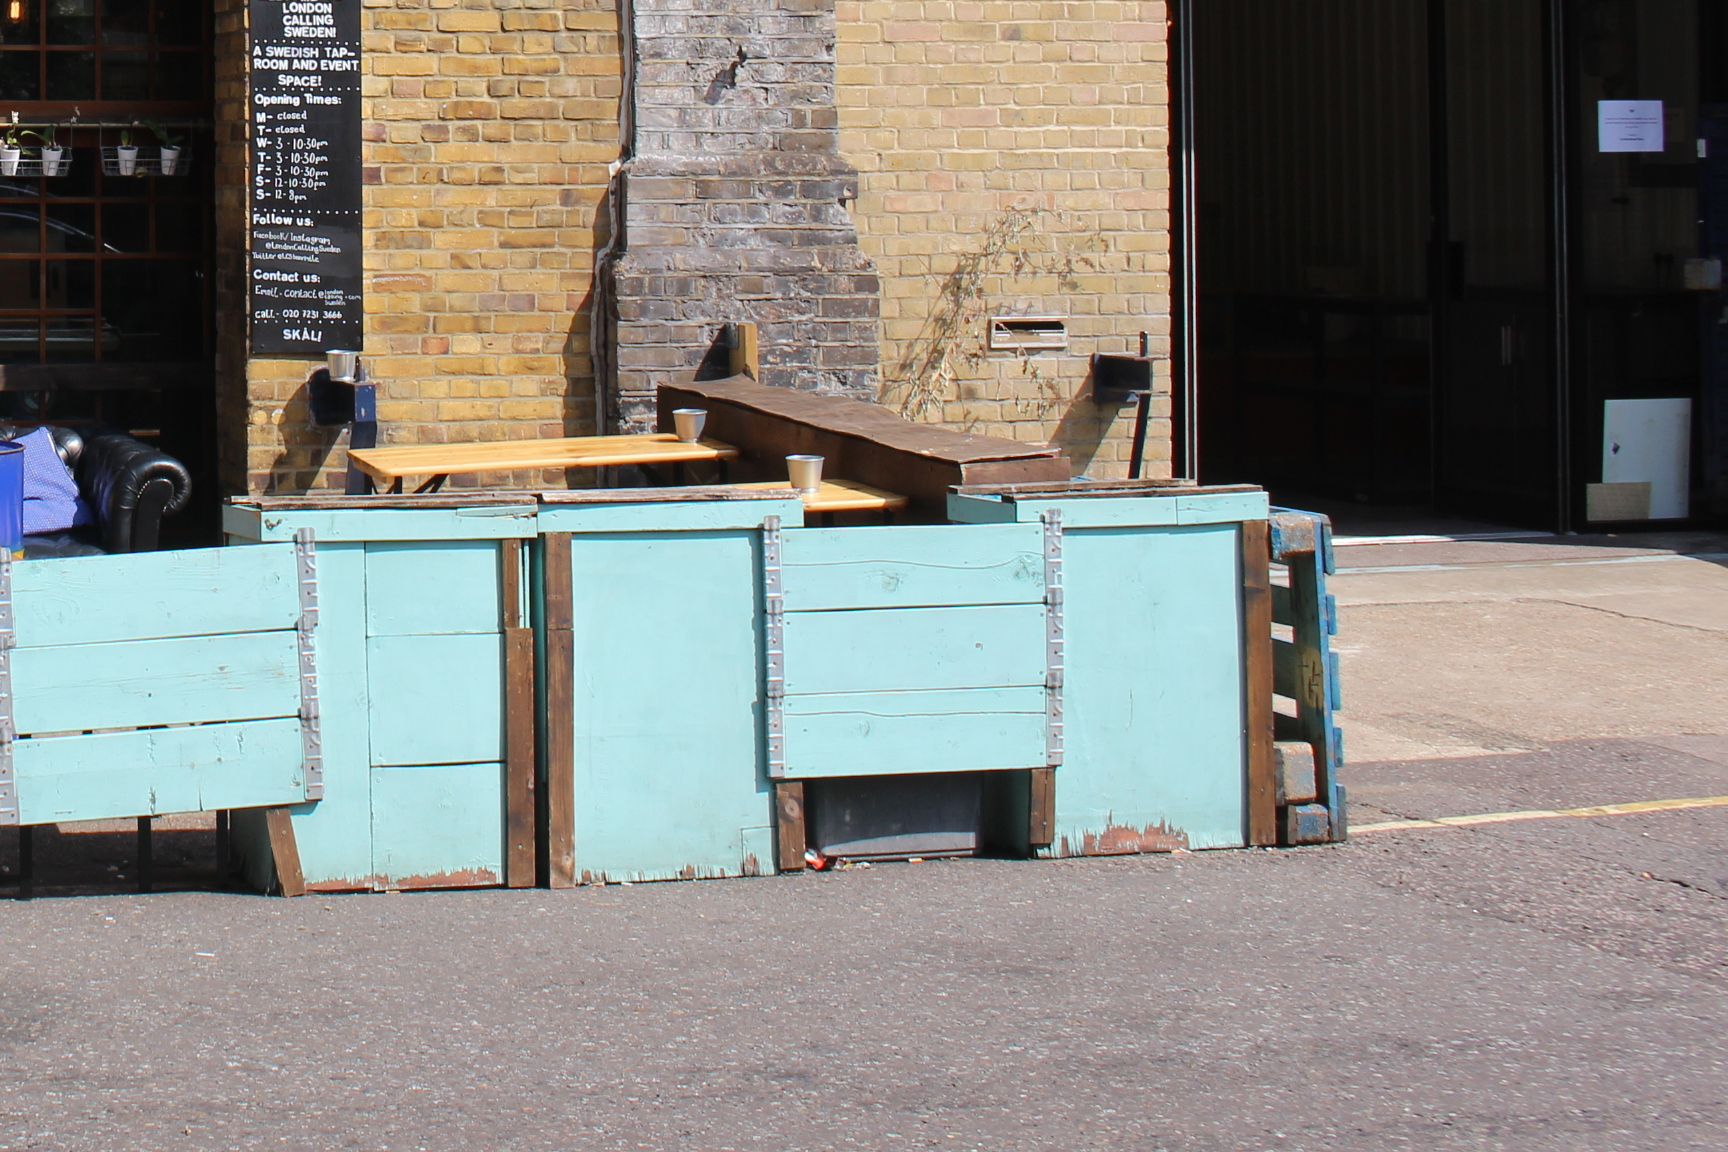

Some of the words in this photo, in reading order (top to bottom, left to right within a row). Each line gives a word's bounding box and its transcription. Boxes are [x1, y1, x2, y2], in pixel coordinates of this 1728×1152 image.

[282, 2, 332, 14] LONDON
[282, 14, 334, 26] CALLING
[283, 26, 337, 38] SWEDEN!
[253, 45, 262, 56] A
[265, 46, 319, 58] SWEDISH
[324, 47, 356, 58] TAP-
[253, 58, 289, 70] ROOM
[292, 59, 318, 71] AND
[320, 59, 359, 71] EVENT
[277, 74, 322, 87] SPACE!
[254, 93, 300, 107] Opening
[304, 93, 342, 105] Times:
[277, 110, 307, 120] closed
[275, 123, 306, 134] closed
[253, 213, 293, 226] Follow
[296, 217, 314, 227] us:
[290, 232, 331, 245] Instagram
[252, 251, 276, 260] Twitter
[253, 268, 299, 282] Contact
[303, 274, 321, 283] us:
[282, 309, 299, 318] 020
[302, 310, 319, 319] 7231
[323, 310, 343, 319] 3666
[282, 327, 323, 342] SKÅL!
